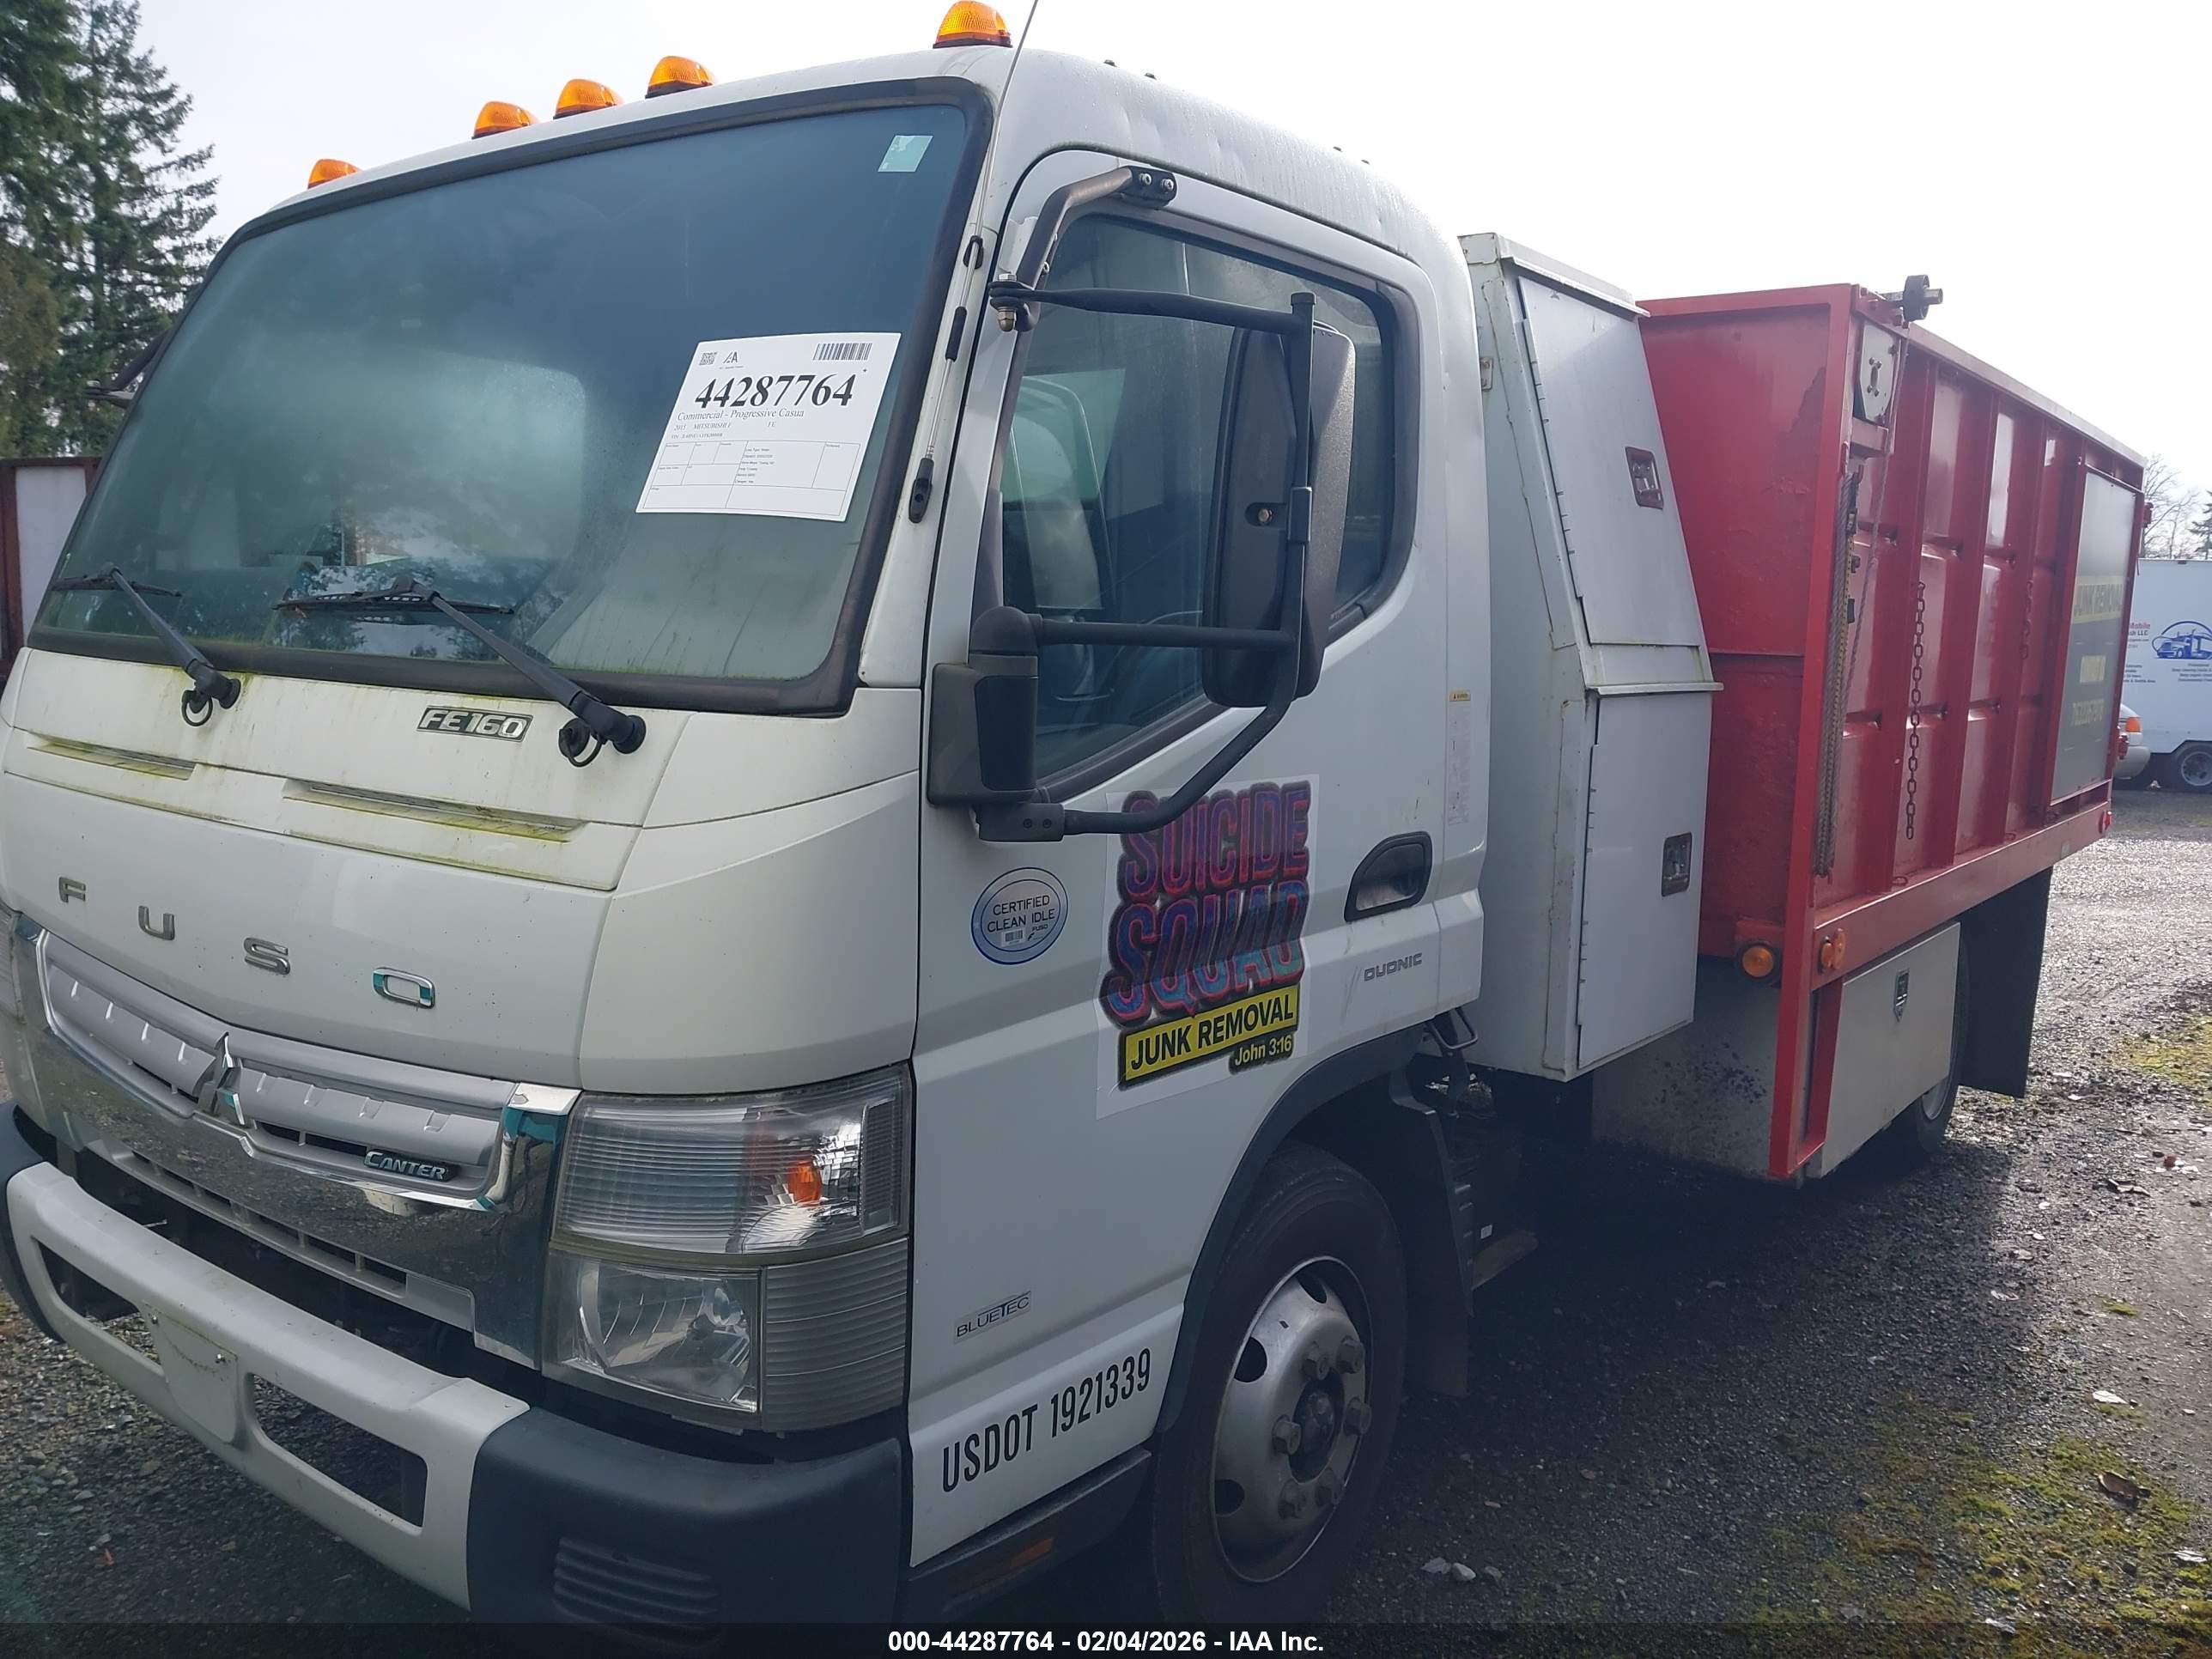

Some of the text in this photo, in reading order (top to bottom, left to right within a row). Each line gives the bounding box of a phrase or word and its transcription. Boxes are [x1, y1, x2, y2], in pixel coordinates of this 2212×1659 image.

[694, 374, 857, 408] 44287764
[677, 412, 724, 421] Commercial
[730, 408, 776, 419] Progressive
[779, 408, 805, 418] Casua
[421, 708, 526, 741] FE160
[1121, 785, 1310, 898] SUICIDE
[988, 908, 1055, 933] CLEAN IDLE
[993, 895, 1050, 915] CERTIFIED
[58, 876, 435, 1008] FUSO
[1104, 879, 1306, 1022] SQUAD
[1364, 952, 1422, 981] DUONIC
[1130, 994, 1294, 1070] JUNK REMOVAL
[1235, 1036, 1292, 1066] John 3:16
[943, 1348, 1151, 1492] USDOT 1921339
